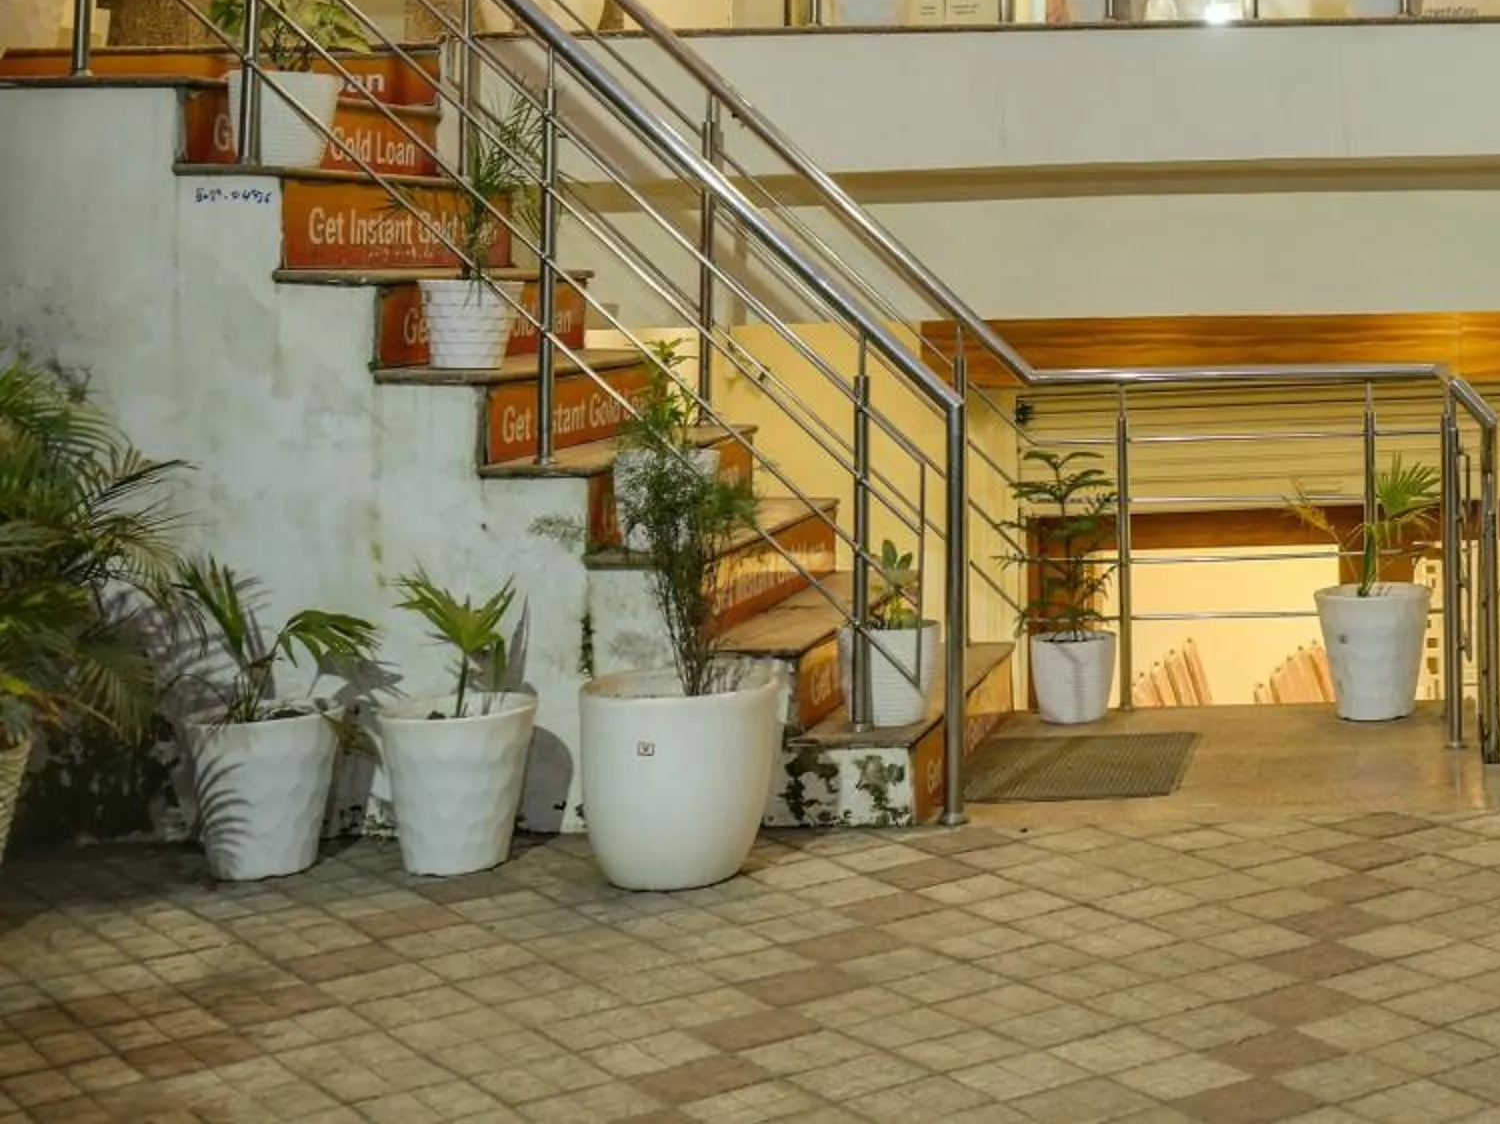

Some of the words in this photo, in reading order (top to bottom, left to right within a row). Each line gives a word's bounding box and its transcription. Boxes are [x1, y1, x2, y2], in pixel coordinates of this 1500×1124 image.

[376, 130, 416, 167] Loan
[309, 206, 345, 245] Get
[350, 209, 413, 245] Instant
[502, 405, 532, 445] Get
